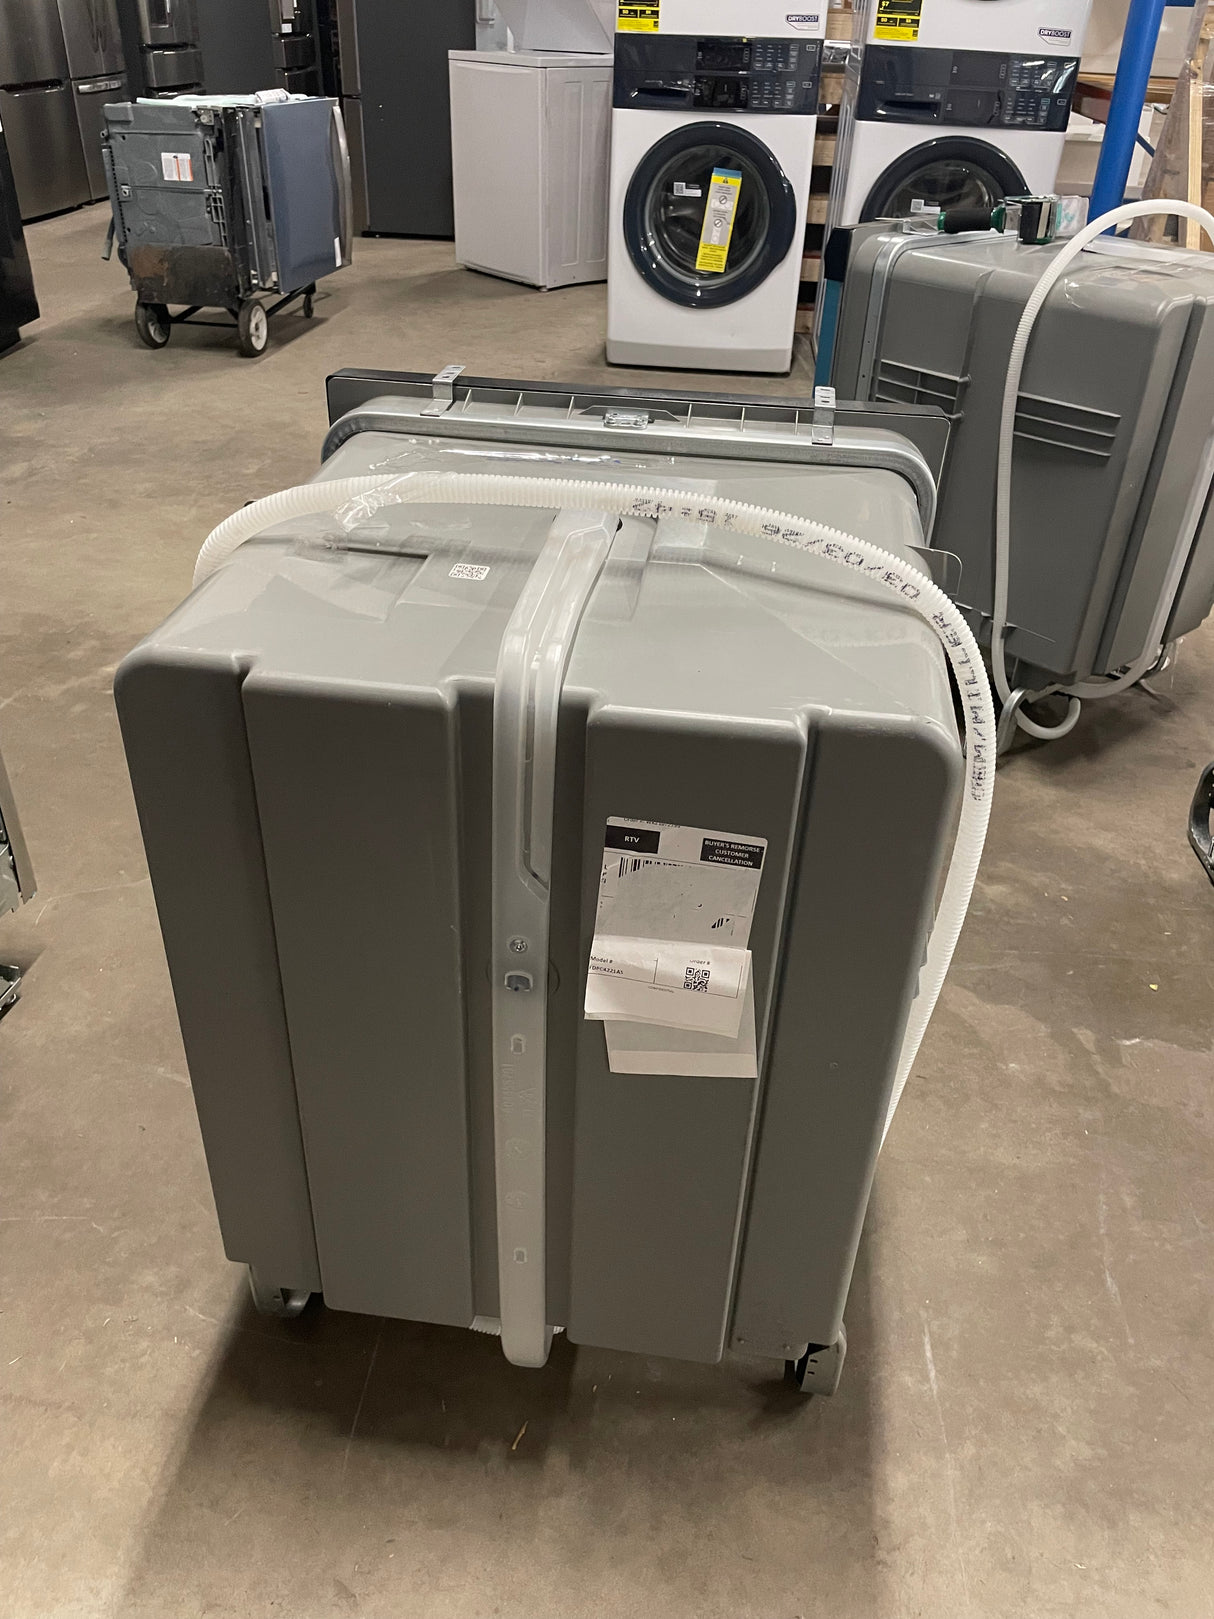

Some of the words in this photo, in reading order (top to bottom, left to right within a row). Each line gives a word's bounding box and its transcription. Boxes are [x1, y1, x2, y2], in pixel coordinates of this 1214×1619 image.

[1040, 29, 1070, 38] DRYBOOST
[624, 835, 640, 844] RTV
[704, 840, 730, 849] BUYER'S
[730, 843, 760, 853] REMORSE
[715, 848, 749, 859] CUSTOMER
[708, 855, 753, 866] CANCELLATION
